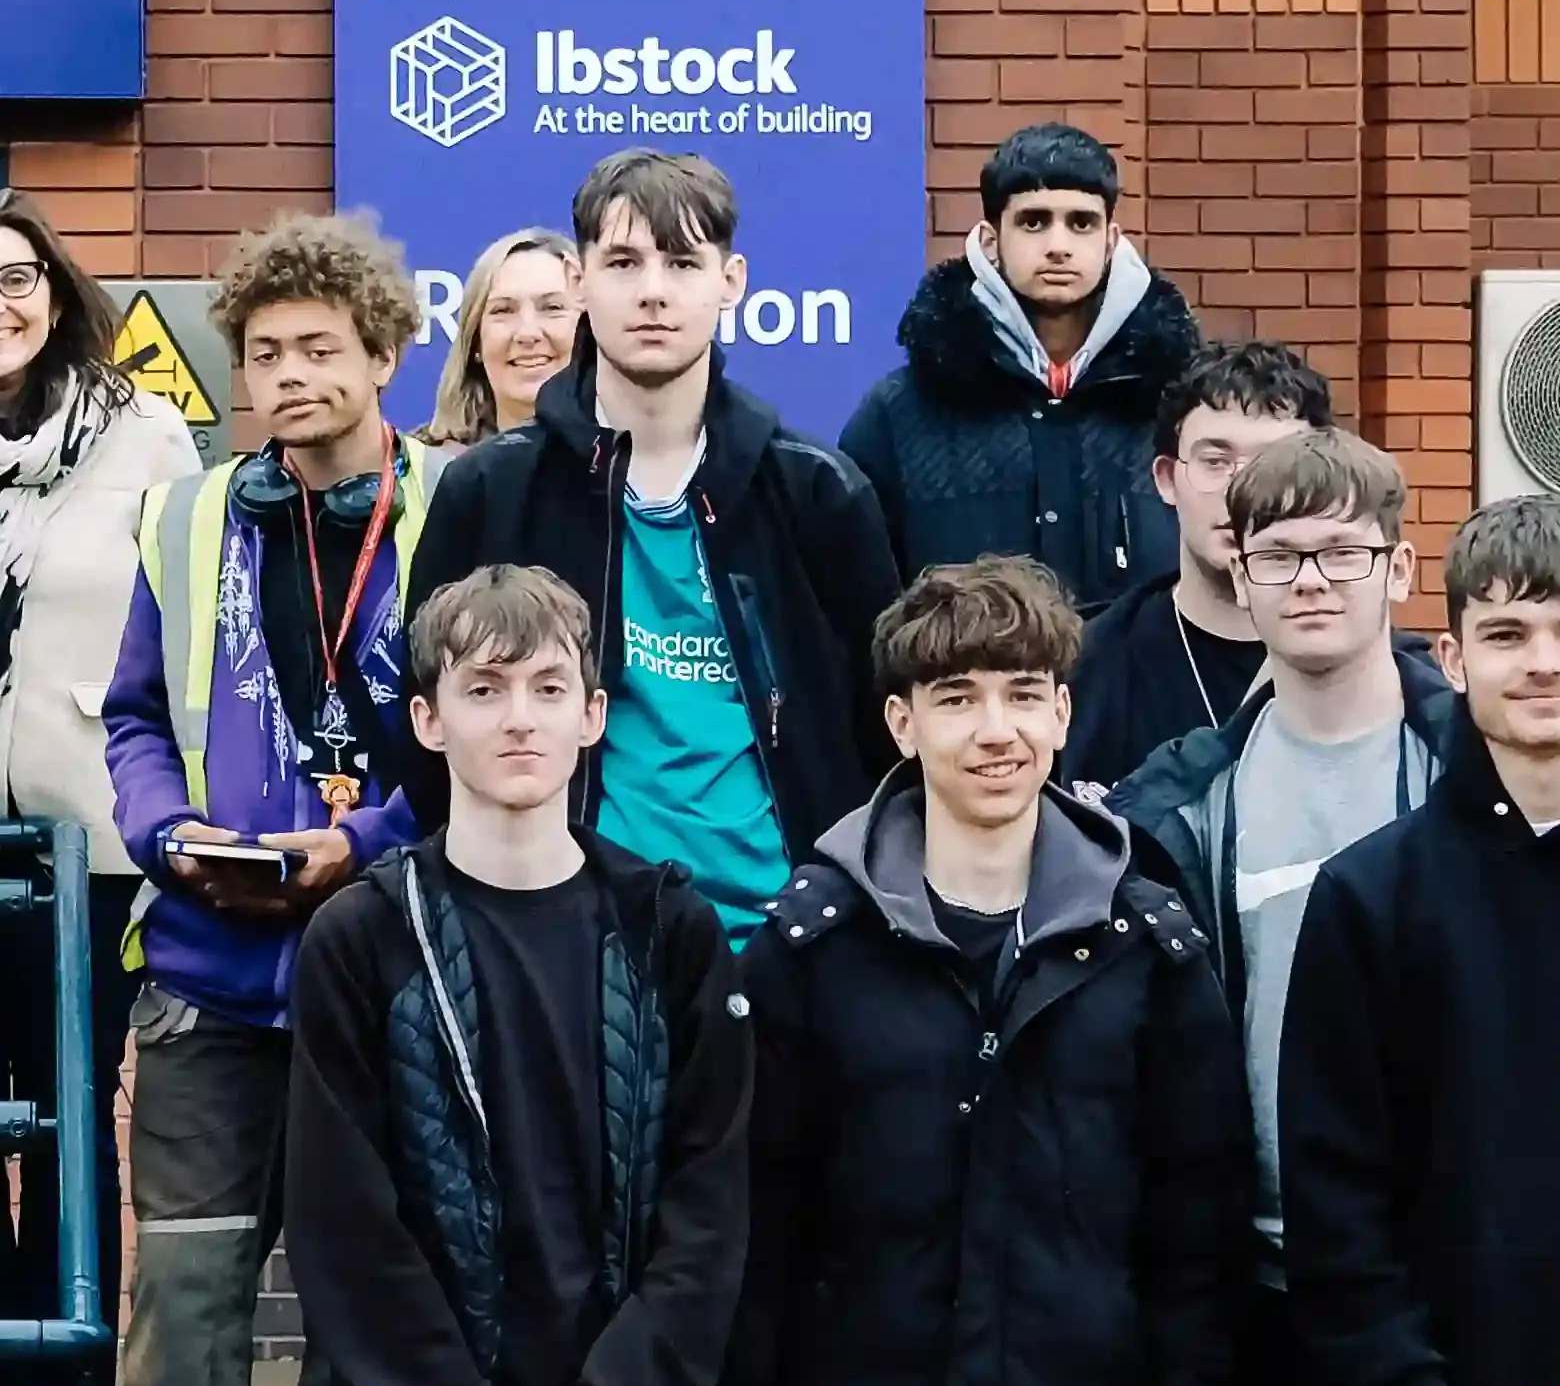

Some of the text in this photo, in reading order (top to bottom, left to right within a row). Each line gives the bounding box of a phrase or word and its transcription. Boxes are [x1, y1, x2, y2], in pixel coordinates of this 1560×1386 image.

[536, 30, 797, 95] Ibstock
[534, 103, 872, 141] At the heart of building
[624, 617, 729, 657] tandar
[624, 642, 737, 682] hartere
